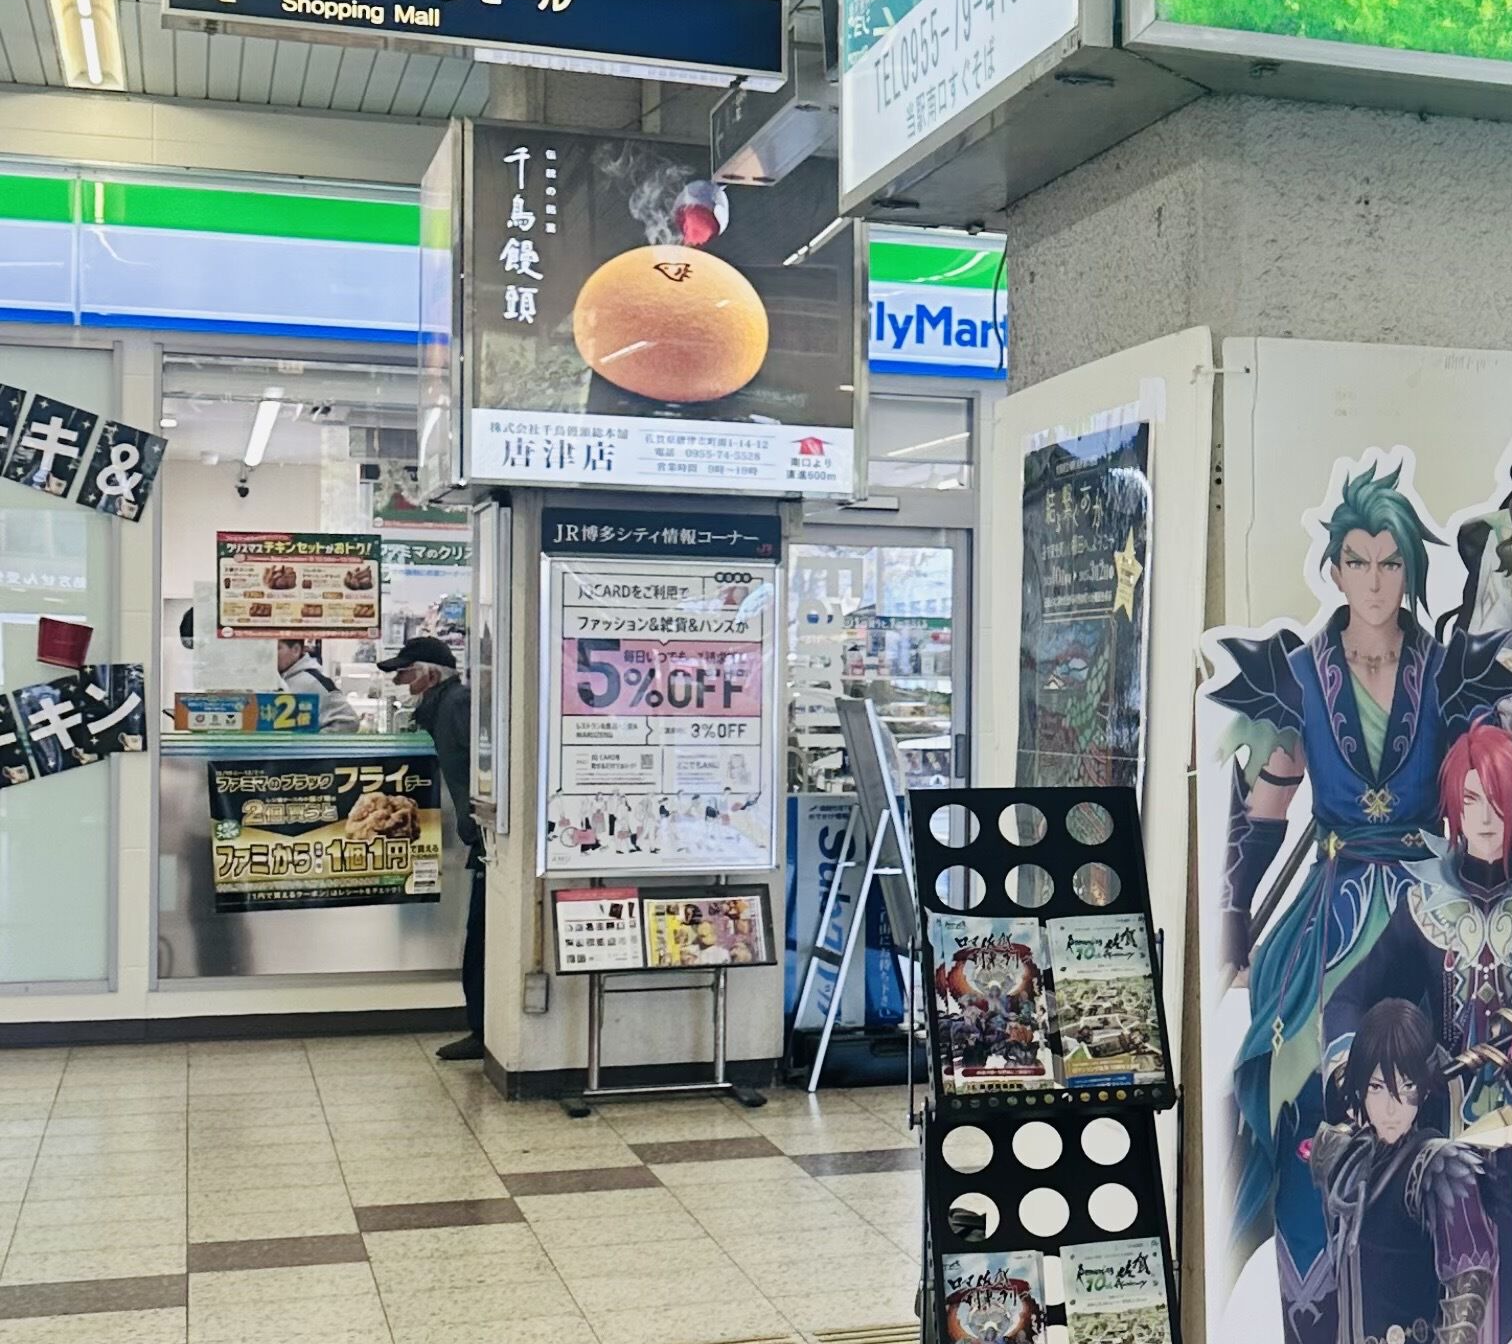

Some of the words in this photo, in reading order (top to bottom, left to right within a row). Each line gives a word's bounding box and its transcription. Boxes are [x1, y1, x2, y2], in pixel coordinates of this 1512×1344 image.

[394, 4, 440, 28] Mall
[906, 36, 996, 138] 当駅南口すぐそば
[499, 146, 544, 324] 千鳥饅頭
[502, 437, 616, 471] 唐津店
[553, 523, 760, 547] JR博多シティ情報コーナー
[577, 638, 744, 709] 5%OFF
[690, 722, 748, 739] 3%OFF
[325, 835, 411, 874] 1個1円
